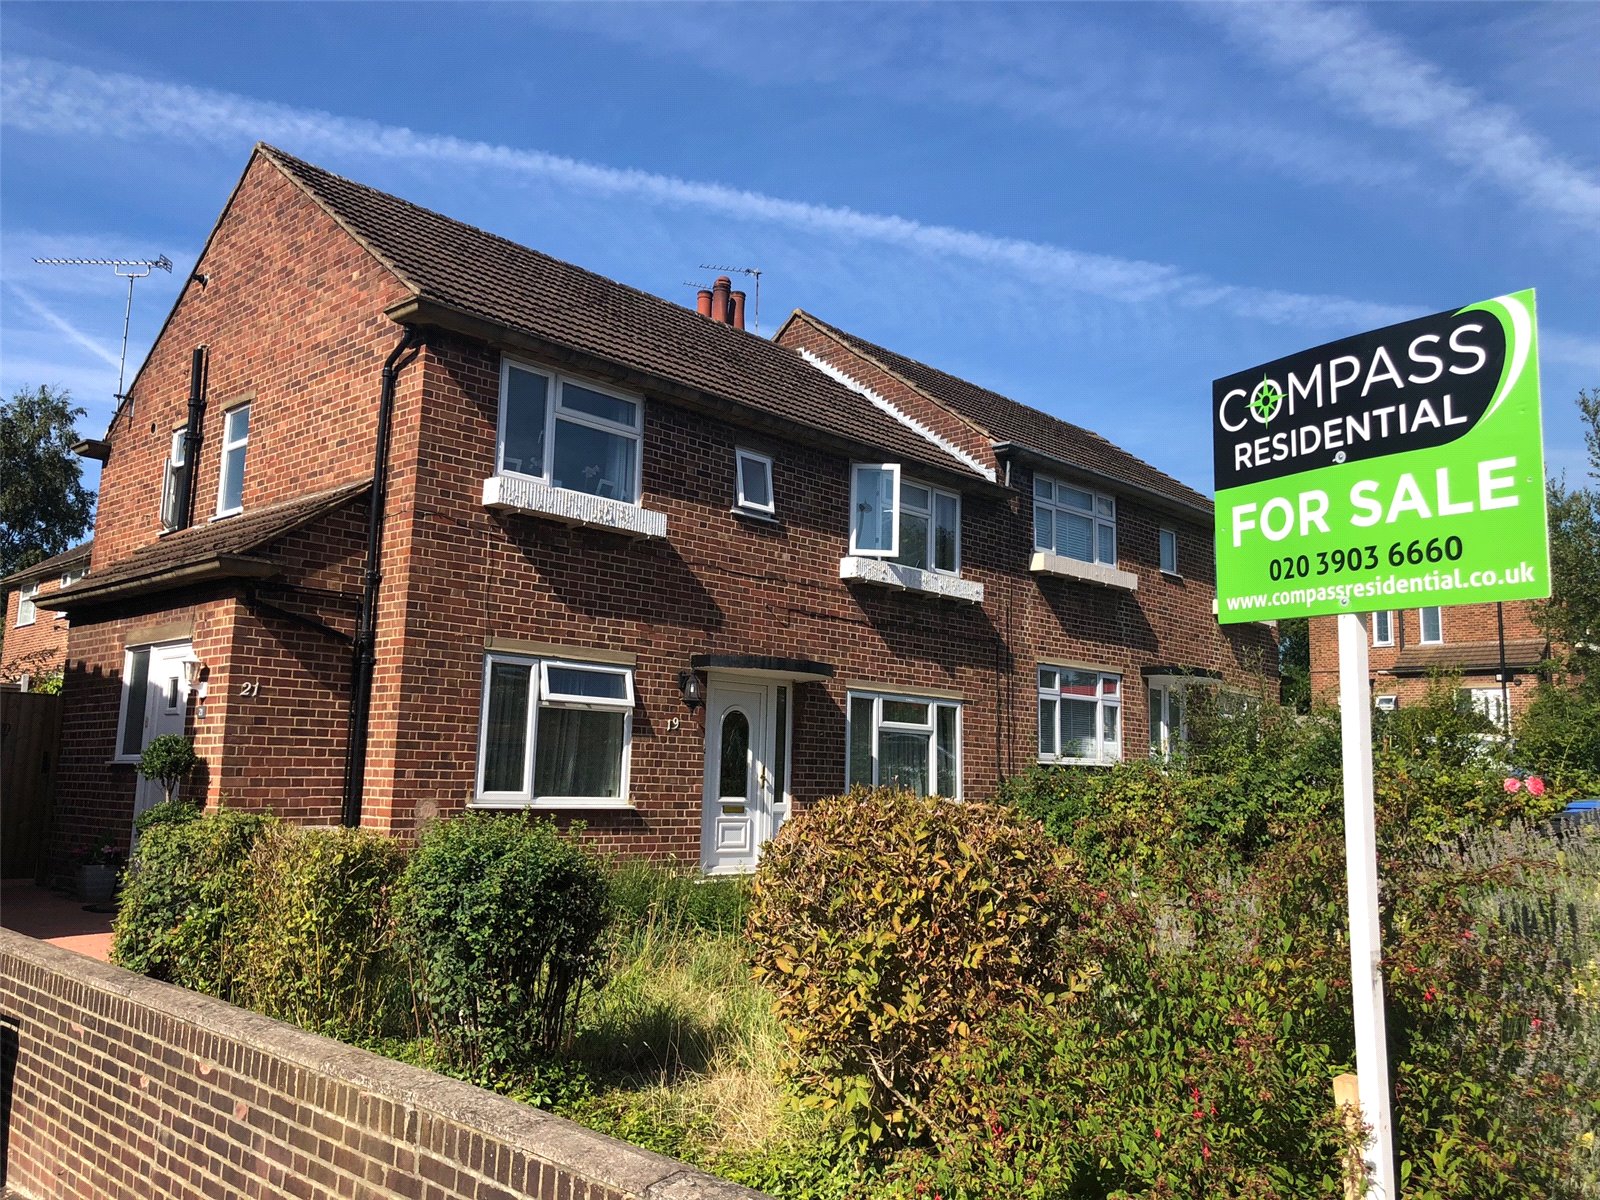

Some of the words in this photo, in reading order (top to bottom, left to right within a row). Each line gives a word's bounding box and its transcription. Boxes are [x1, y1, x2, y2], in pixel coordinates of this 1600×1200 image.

[1219, 324, 1487, 432] COMPASS
[1234, 394, 1468, 471] RESIDENTIAL
[1231, 489, 1331, 548] FOR
[1350, 455, 1519, 528] SALE
[1269, 555, 1310, 581] 020
[1316, 545, 1380, 574] 3903
[1388, 535, 1463, 567] 6660
[1226, 561, 1536, 611] www.compassresidential.co.uk
[240, 682, 259, 697] 21
[667, 717, 679, 731] 19
